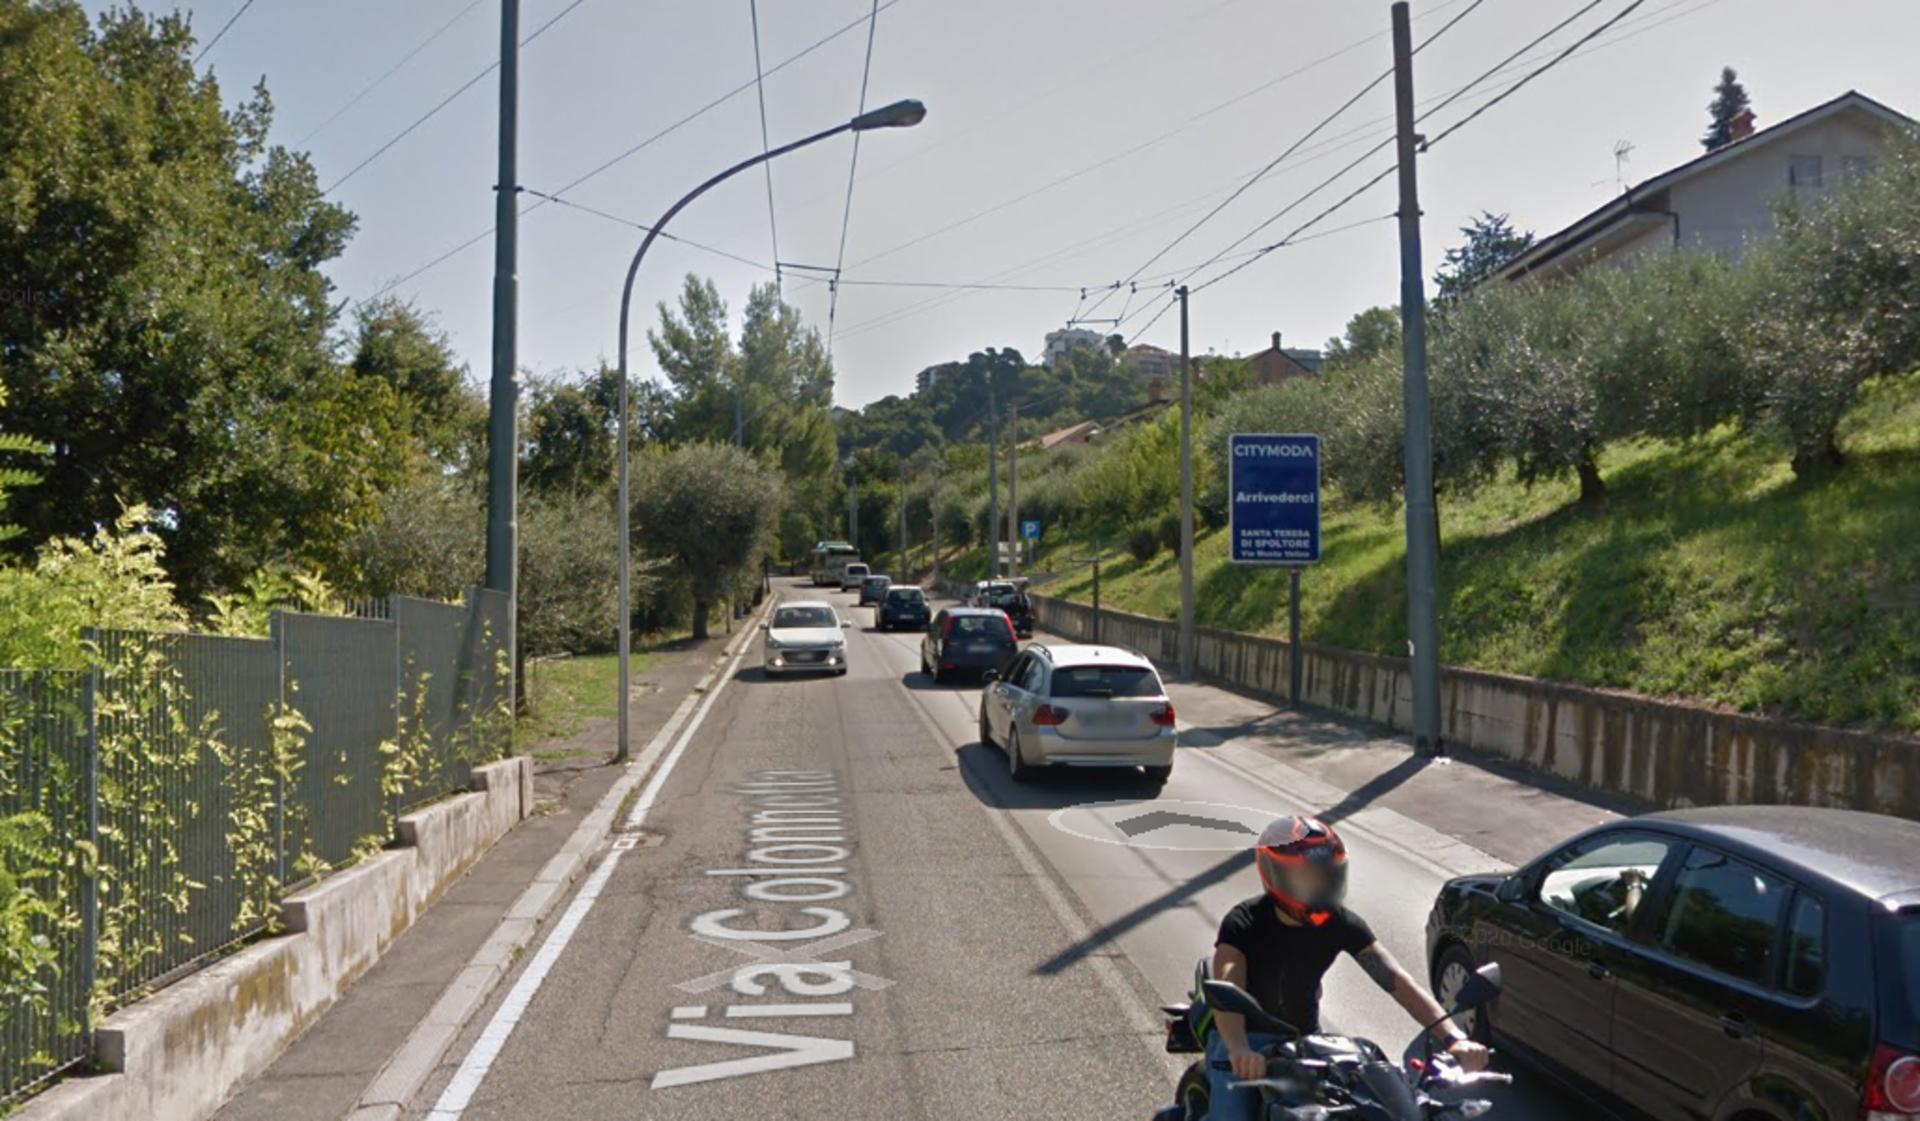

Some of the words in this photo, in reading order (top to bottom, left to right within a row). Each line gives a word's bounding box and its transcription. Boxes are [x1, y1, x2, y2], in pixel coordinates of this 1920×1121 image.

[1234, 444, 1313, 457] CITYMODA
[1236, 492, 1315, 504] Arrivederci
[1241, 529, 1272, 538] SANTA
[1241, 539, 1252, 548] DI
[1255, 539, 1311, 548] SPOLTORE
